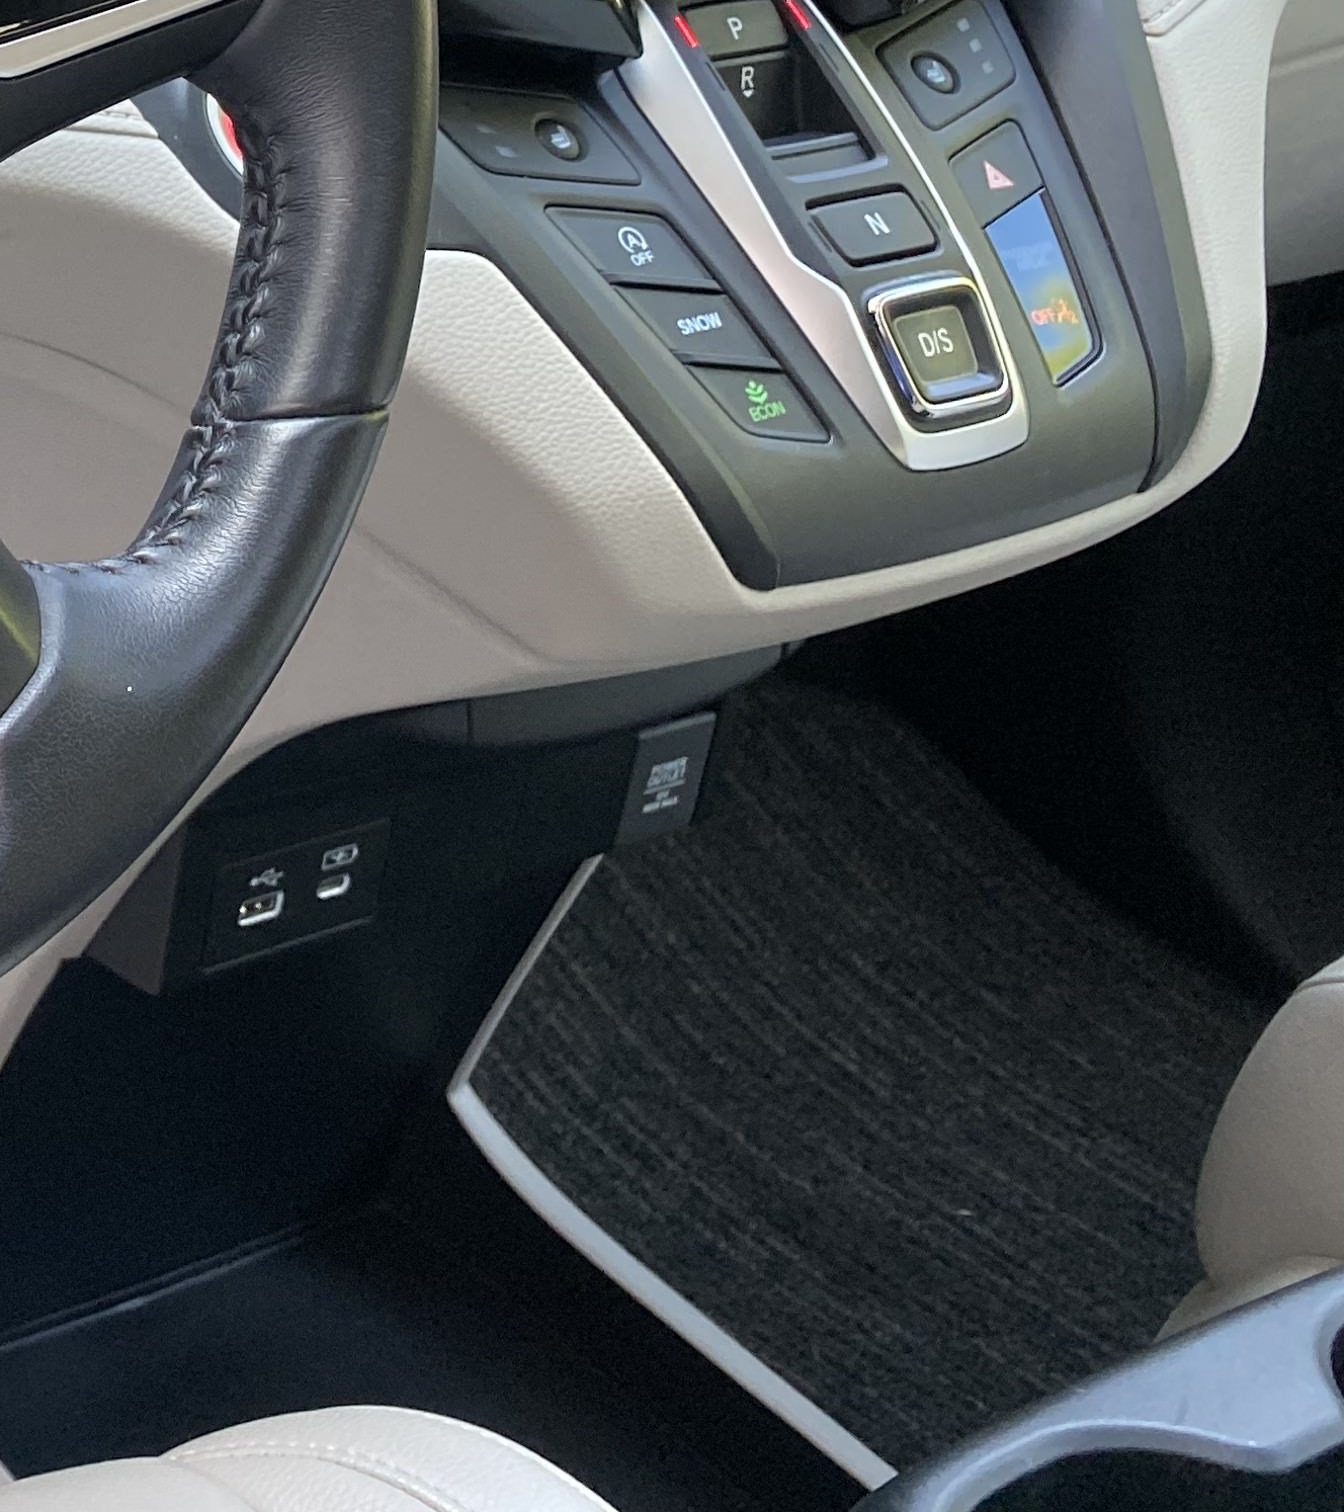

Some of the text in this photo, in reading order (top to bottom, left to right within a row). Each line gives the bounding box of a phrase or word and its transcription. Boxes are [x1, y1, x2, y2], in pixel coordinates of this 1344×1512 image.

[727, 17, 743, 41] P
[740, 66, 755, 91] R
[863, 212, 890, 236] N
[630, 250, 654, 266] OFF
[676, 311, 723, 335] SNOW
[918, 329, 954, 357] D/S
[748, 400, 786, 422] ECON
